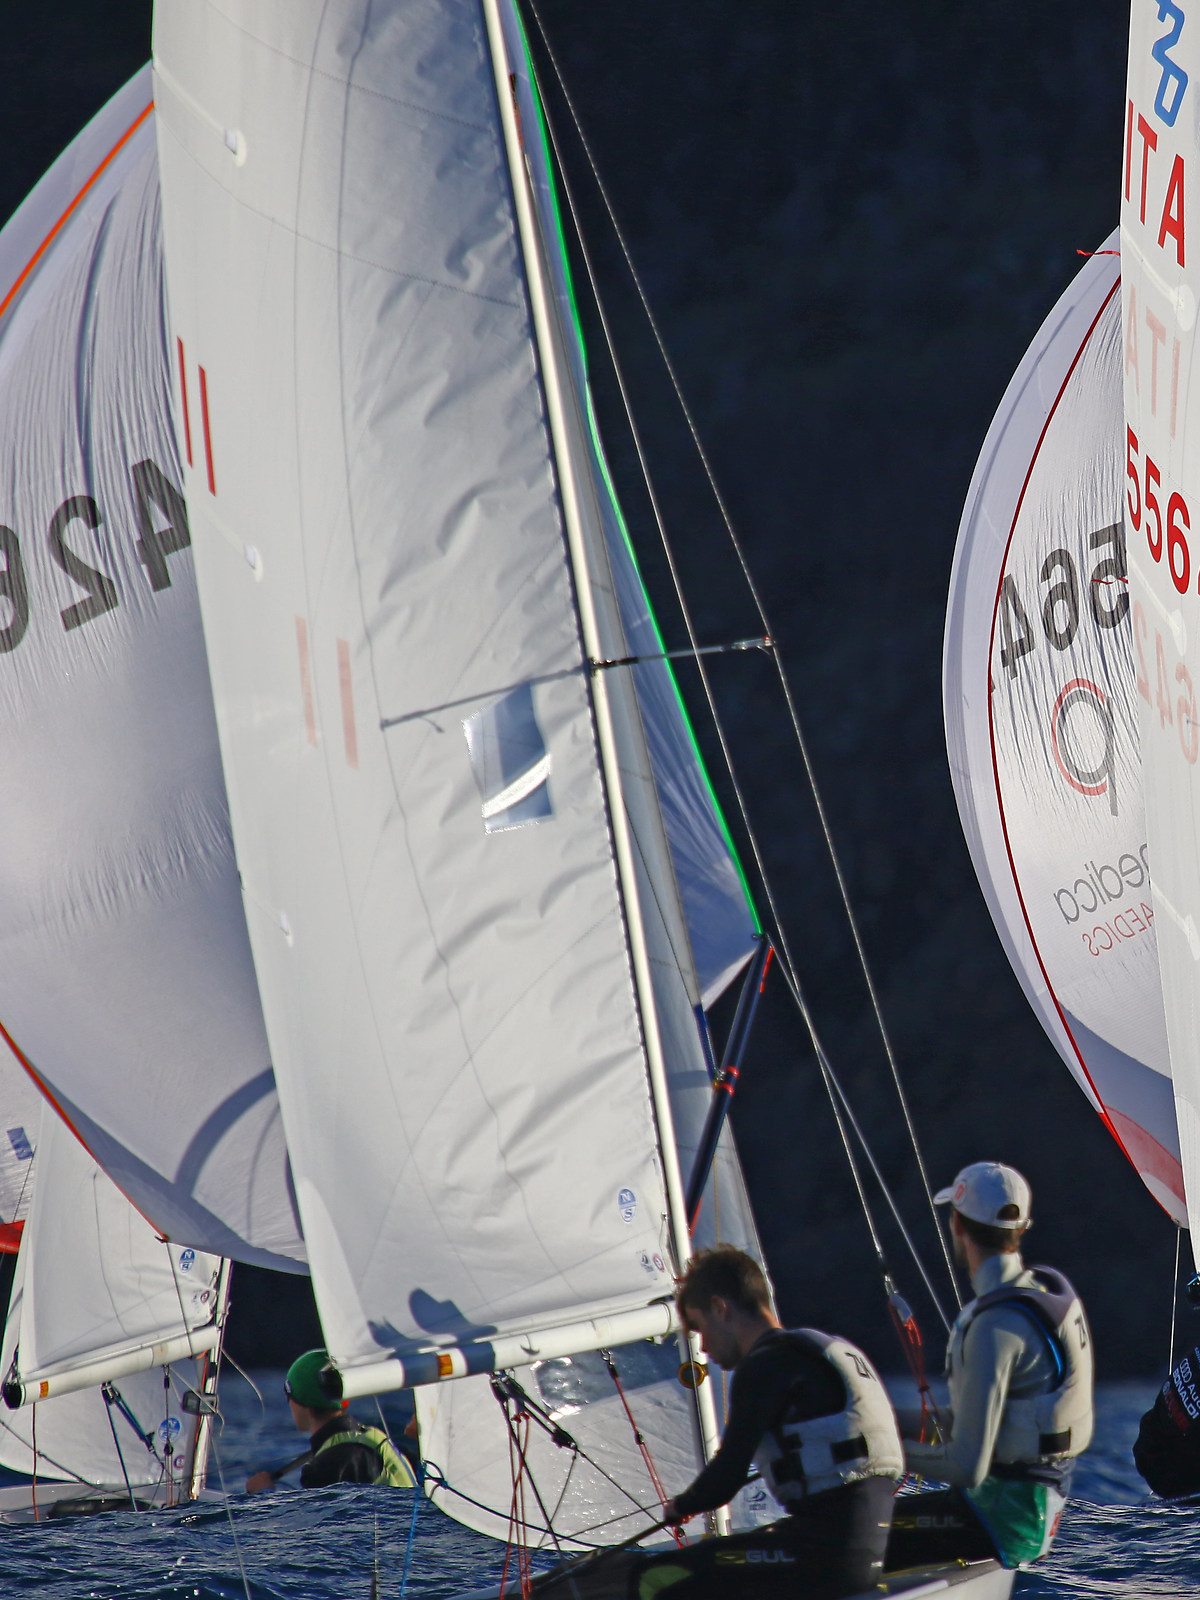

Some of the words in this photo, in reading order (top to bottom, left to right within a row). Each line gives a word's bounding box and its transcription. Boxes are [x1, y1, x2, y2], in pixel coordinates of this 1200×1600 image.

[1151, 0, 1188, 127] 20
[1125, 99, 1185, 268] ITA
[1173, 1367, 1200, 1419] BONALDI
[745, 1549, 796, 1564] GUL
